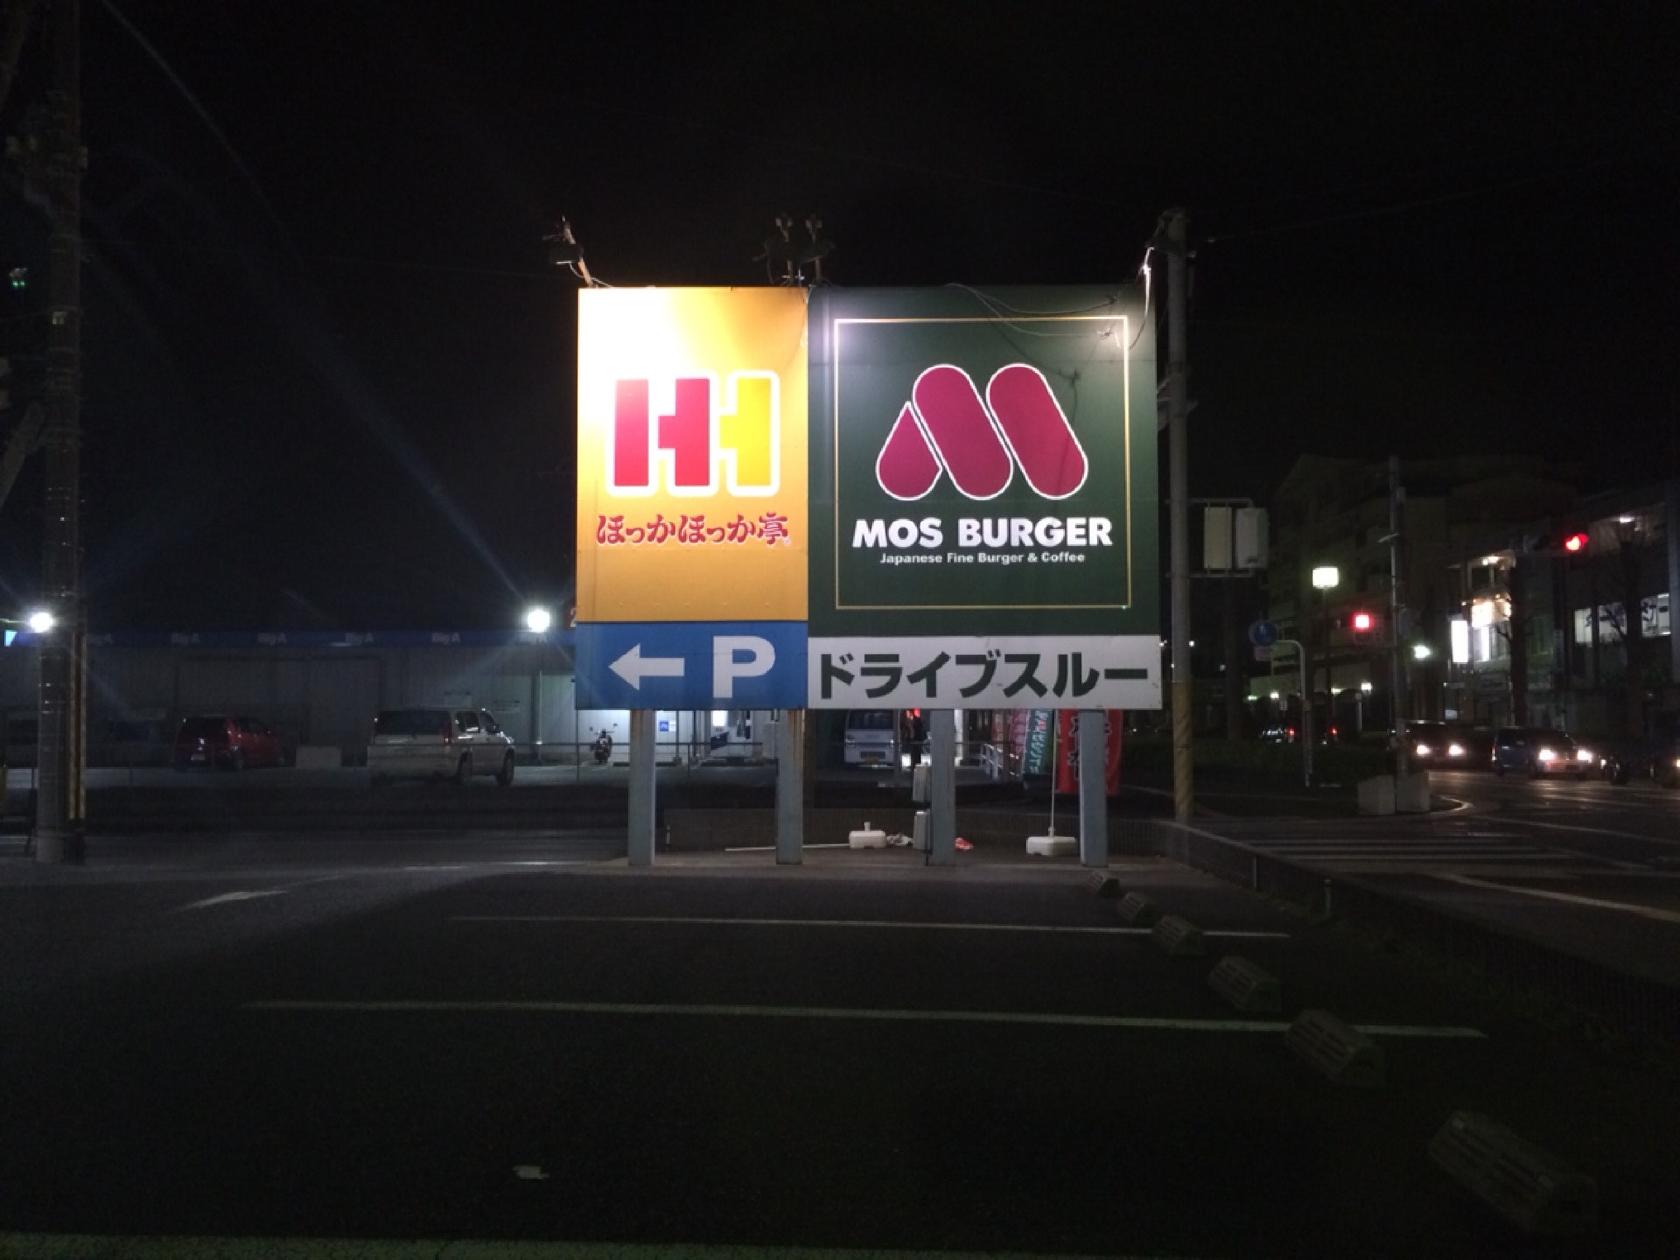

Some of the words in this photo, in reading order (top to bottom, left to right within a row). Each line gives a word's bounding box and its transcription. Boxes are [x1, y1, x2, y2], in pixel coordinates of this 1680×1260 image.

[596, 512, 790, 545] ほっかほっか亭
[852, 517, 943, 548] MOS
[958, 516, 1113, 548] BURGER
[879, 552, 943, 566] Japanese
[947, 552, 974, 564] Fine
[978, 552, 1024, 566] Burger
[1028, 552, 1038, 564] &
[1041, 551, 1086, 563] Coffee
[713, 636, 776, 699] P
[820, 649, 1149, 700] ドライブスルー
